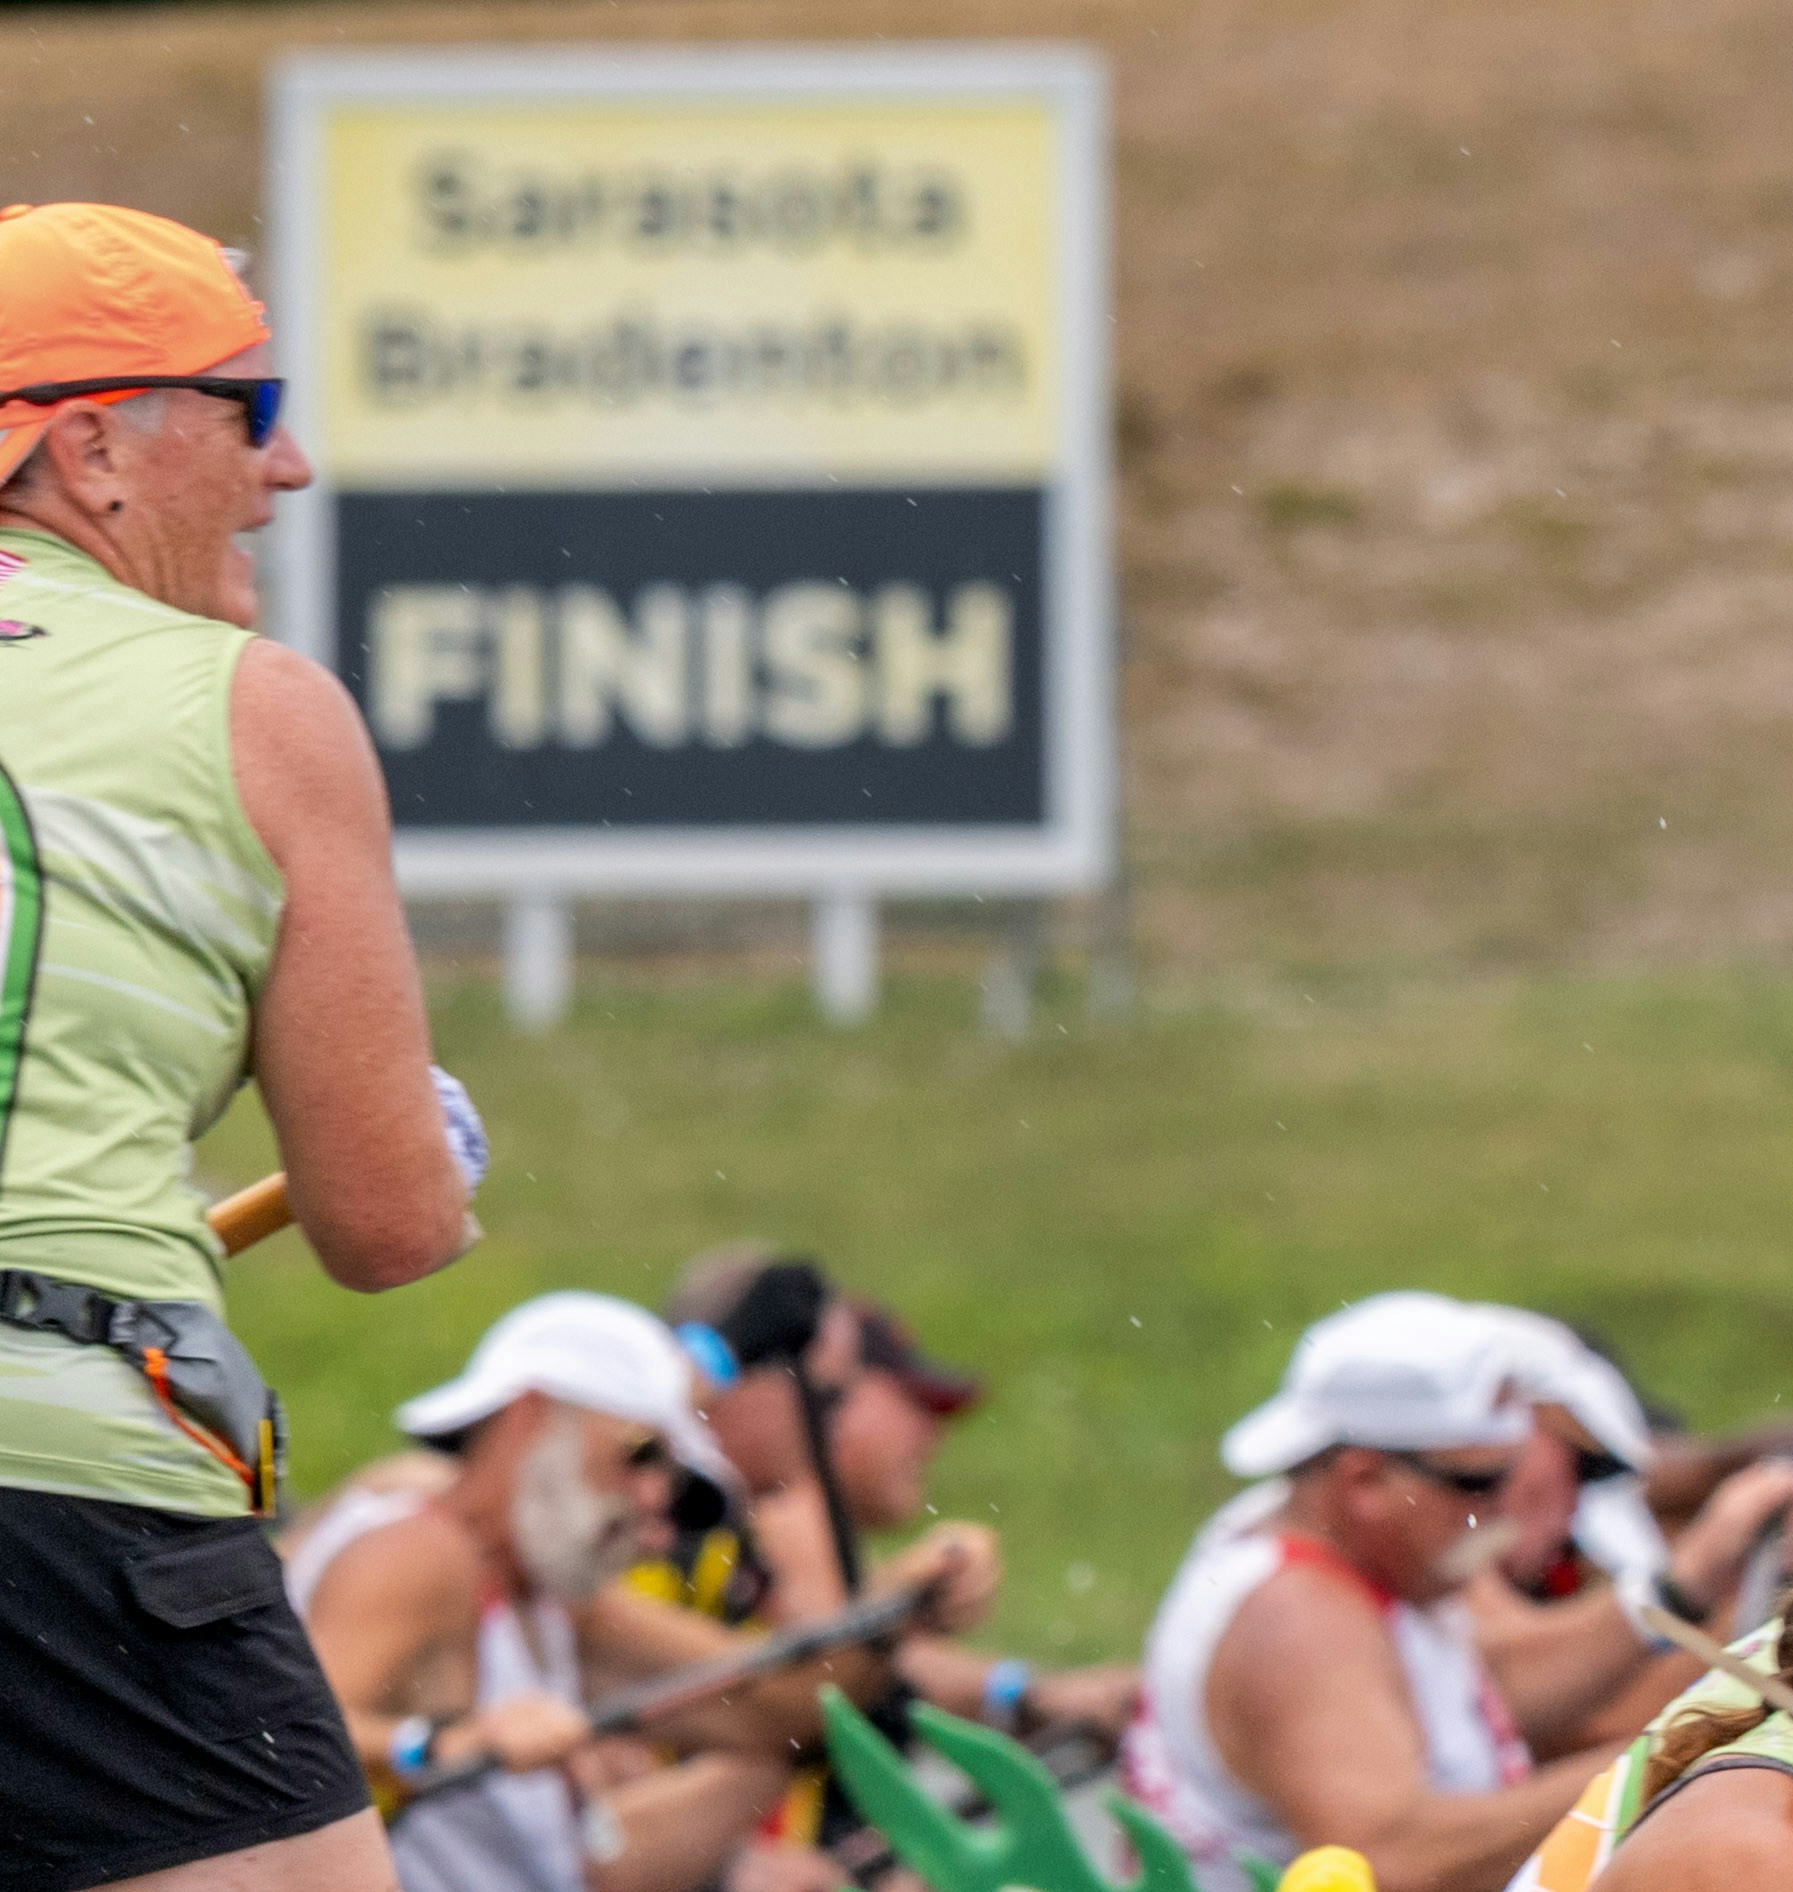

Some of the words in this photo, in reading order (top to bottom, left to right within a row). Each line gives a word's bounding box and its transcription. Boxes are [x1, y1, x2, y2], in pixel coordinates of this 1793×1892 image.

[417, 146, 966, 252] Sarasota
[366, 304, 1026, 404] Bradenton
[368, 583, 1009, 747] FINISH
